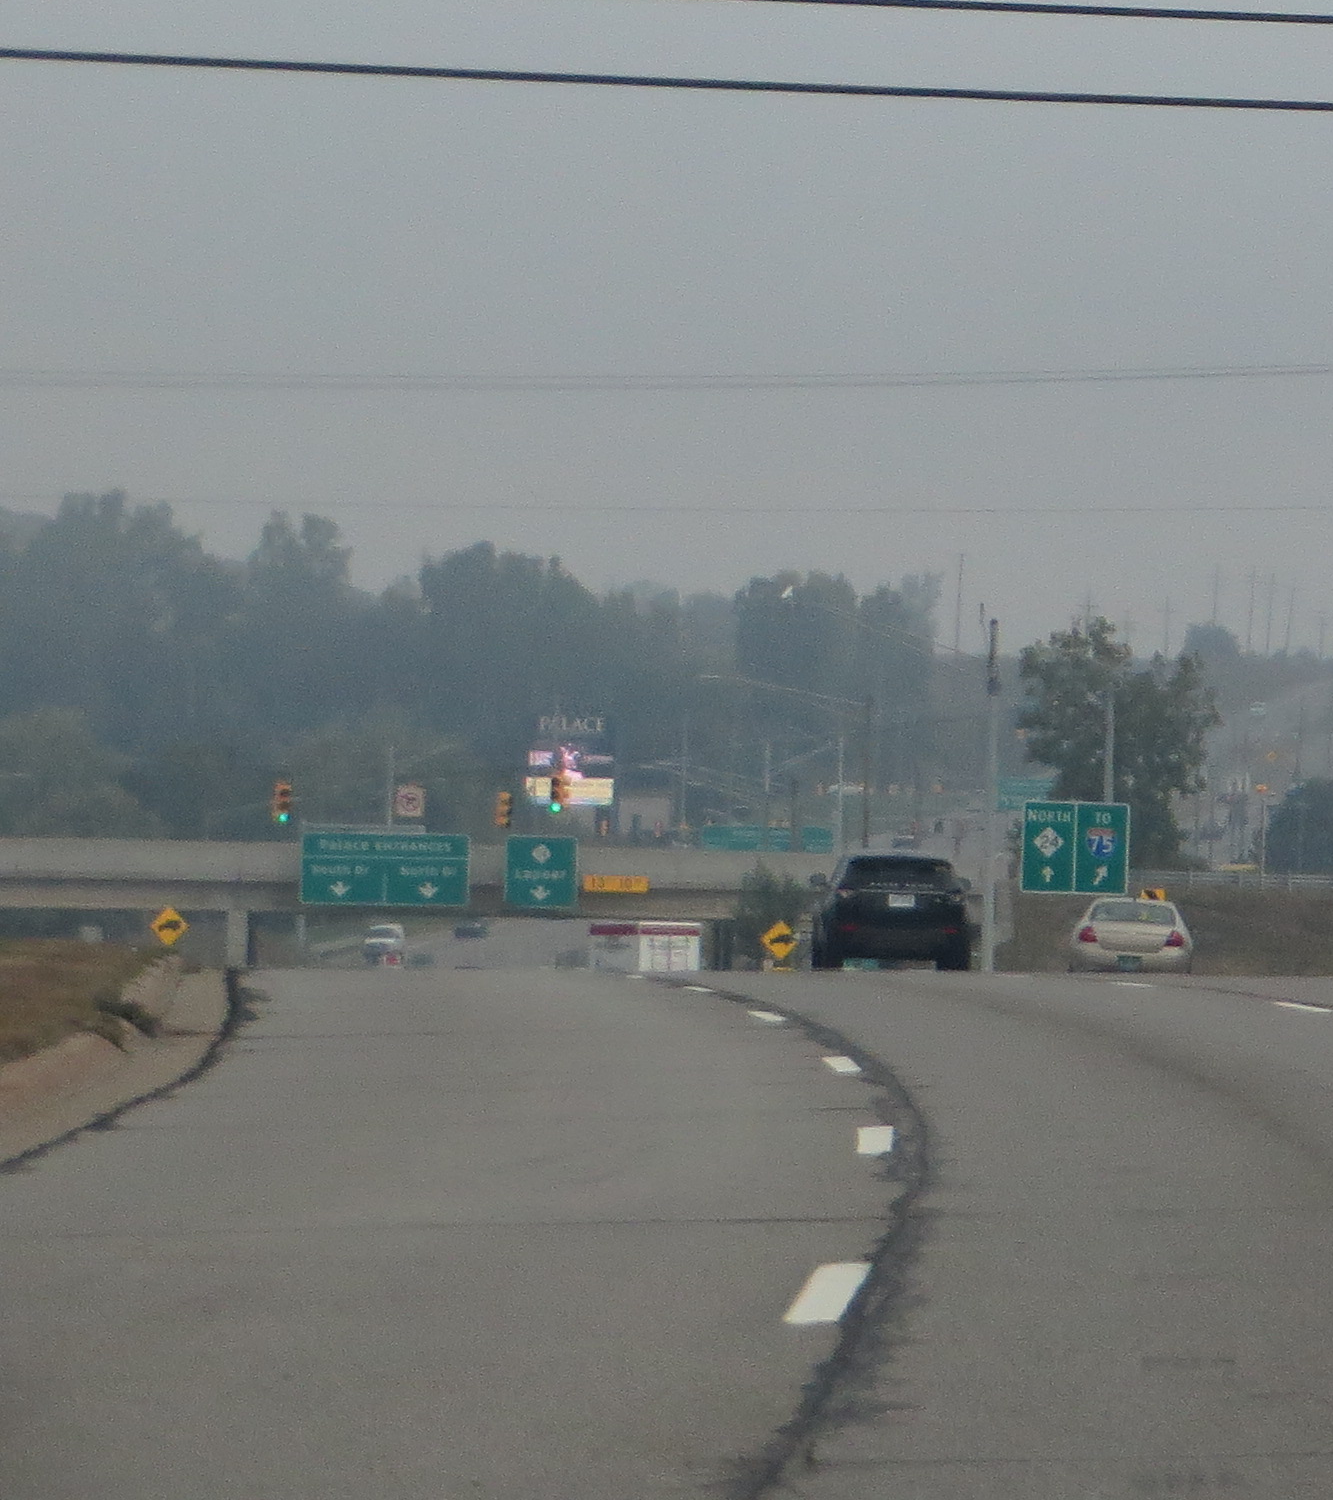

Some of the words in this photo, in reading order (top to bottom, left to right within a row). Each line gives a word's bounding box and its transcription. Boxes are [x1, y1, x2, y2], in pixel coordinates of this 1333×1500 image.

[1027, 808, 1072, 823] NORTH
[1095, 811, 1112, 825] TO
[1089, 835, 1113, 853] 75
